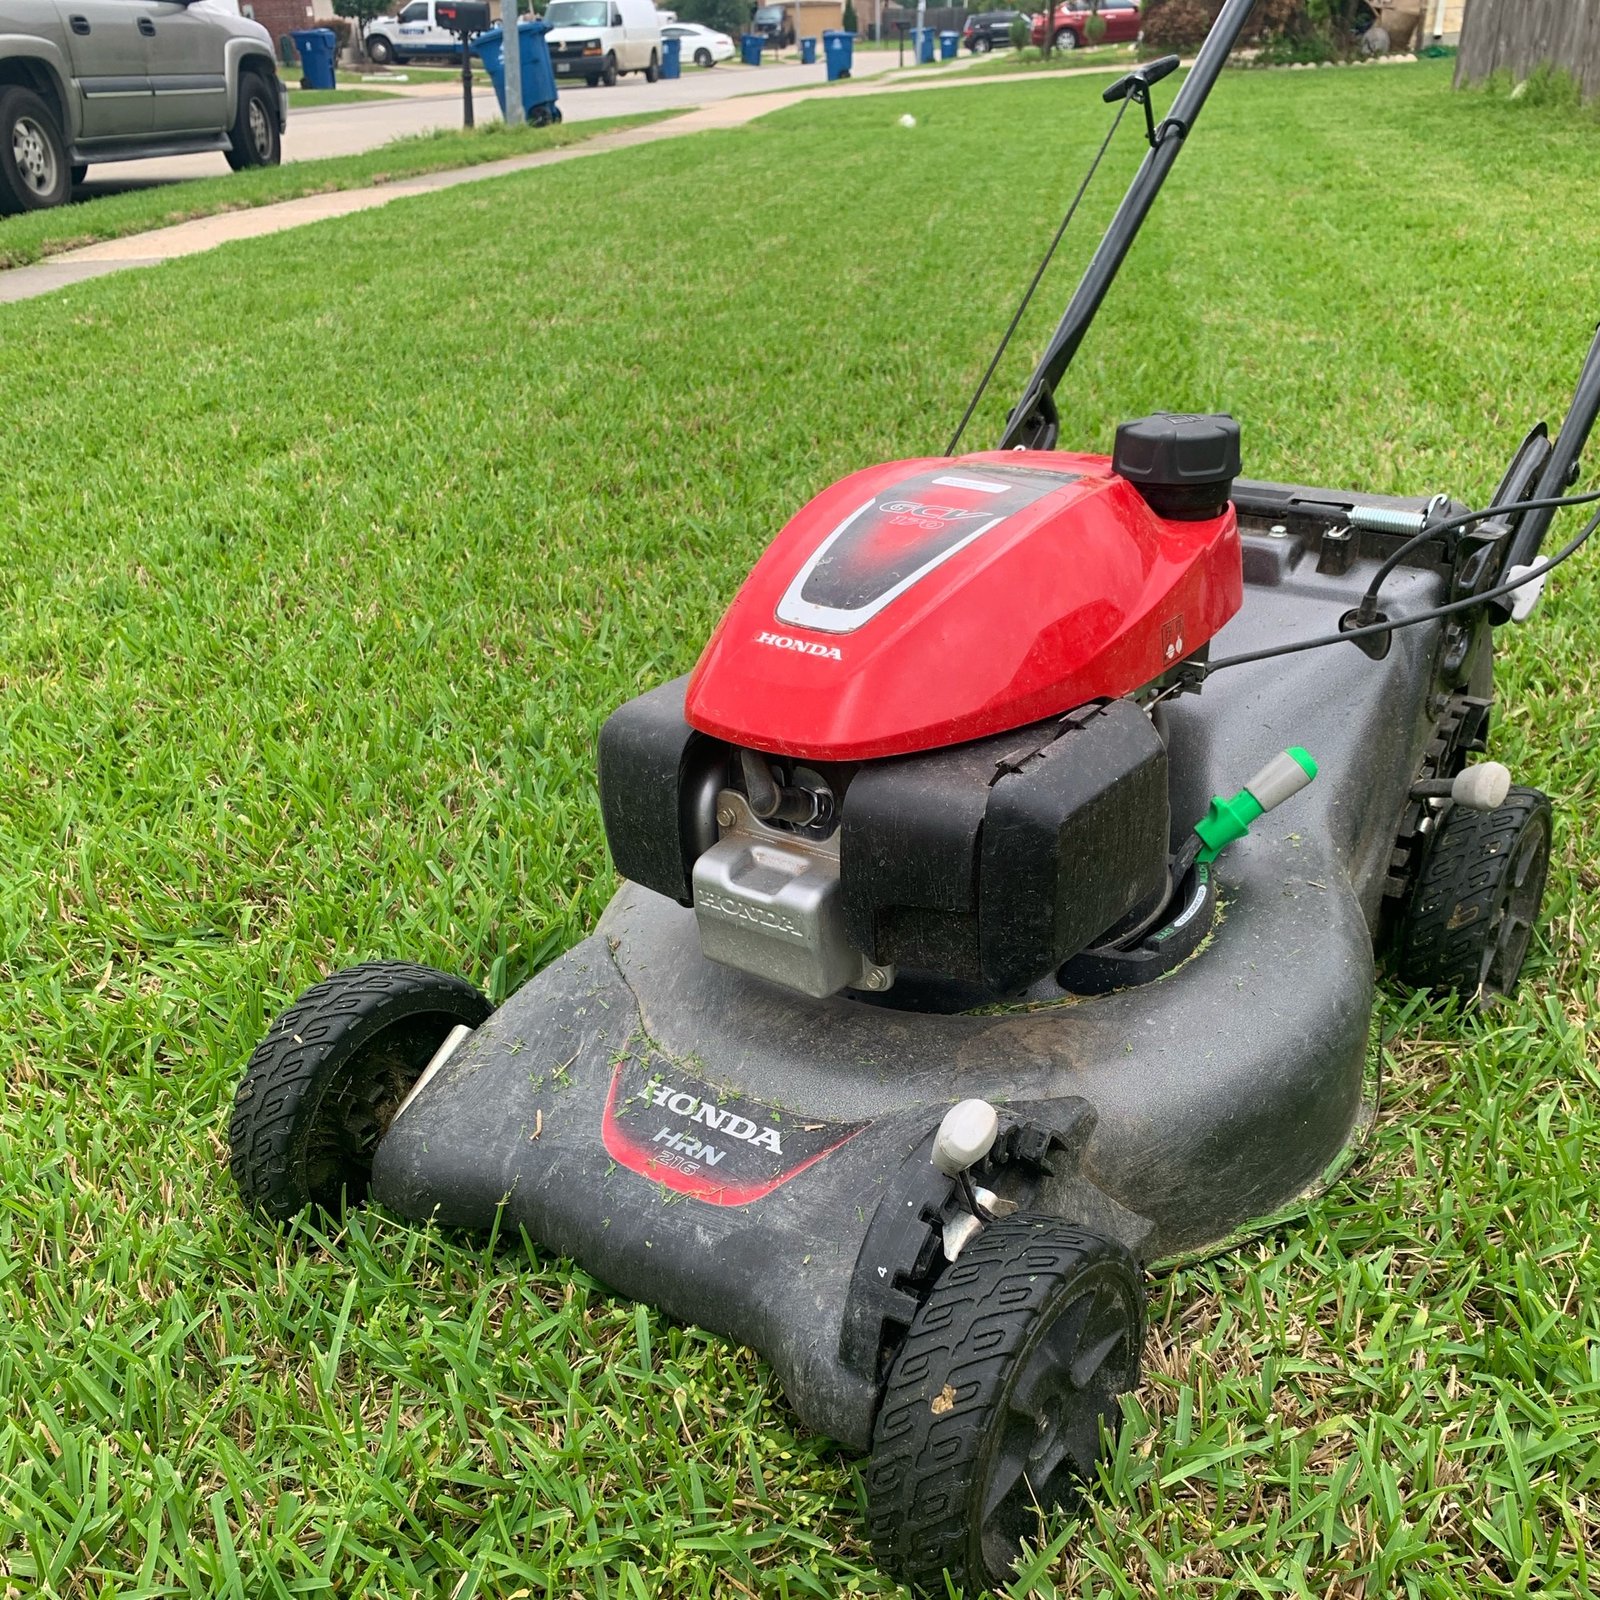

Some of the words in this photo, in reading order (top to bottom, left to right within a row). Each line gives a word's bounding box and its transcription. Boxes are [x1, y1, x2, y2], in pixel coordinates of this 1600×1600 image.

[879, 500, 994, 521] GCV
[889, 515, 945, 530] 170
[756, 631, 843, 661] HONDA
[698, 889, 804, 937] HONDA
[1155, 927, 1175, 940] BAG
[636, 1079, 784, 1156] HONDA
[652, 1126, 727, 1167] HRN
[653, 1150, 701, 1176] 216
[877, 1266, 888, 1278] 4
